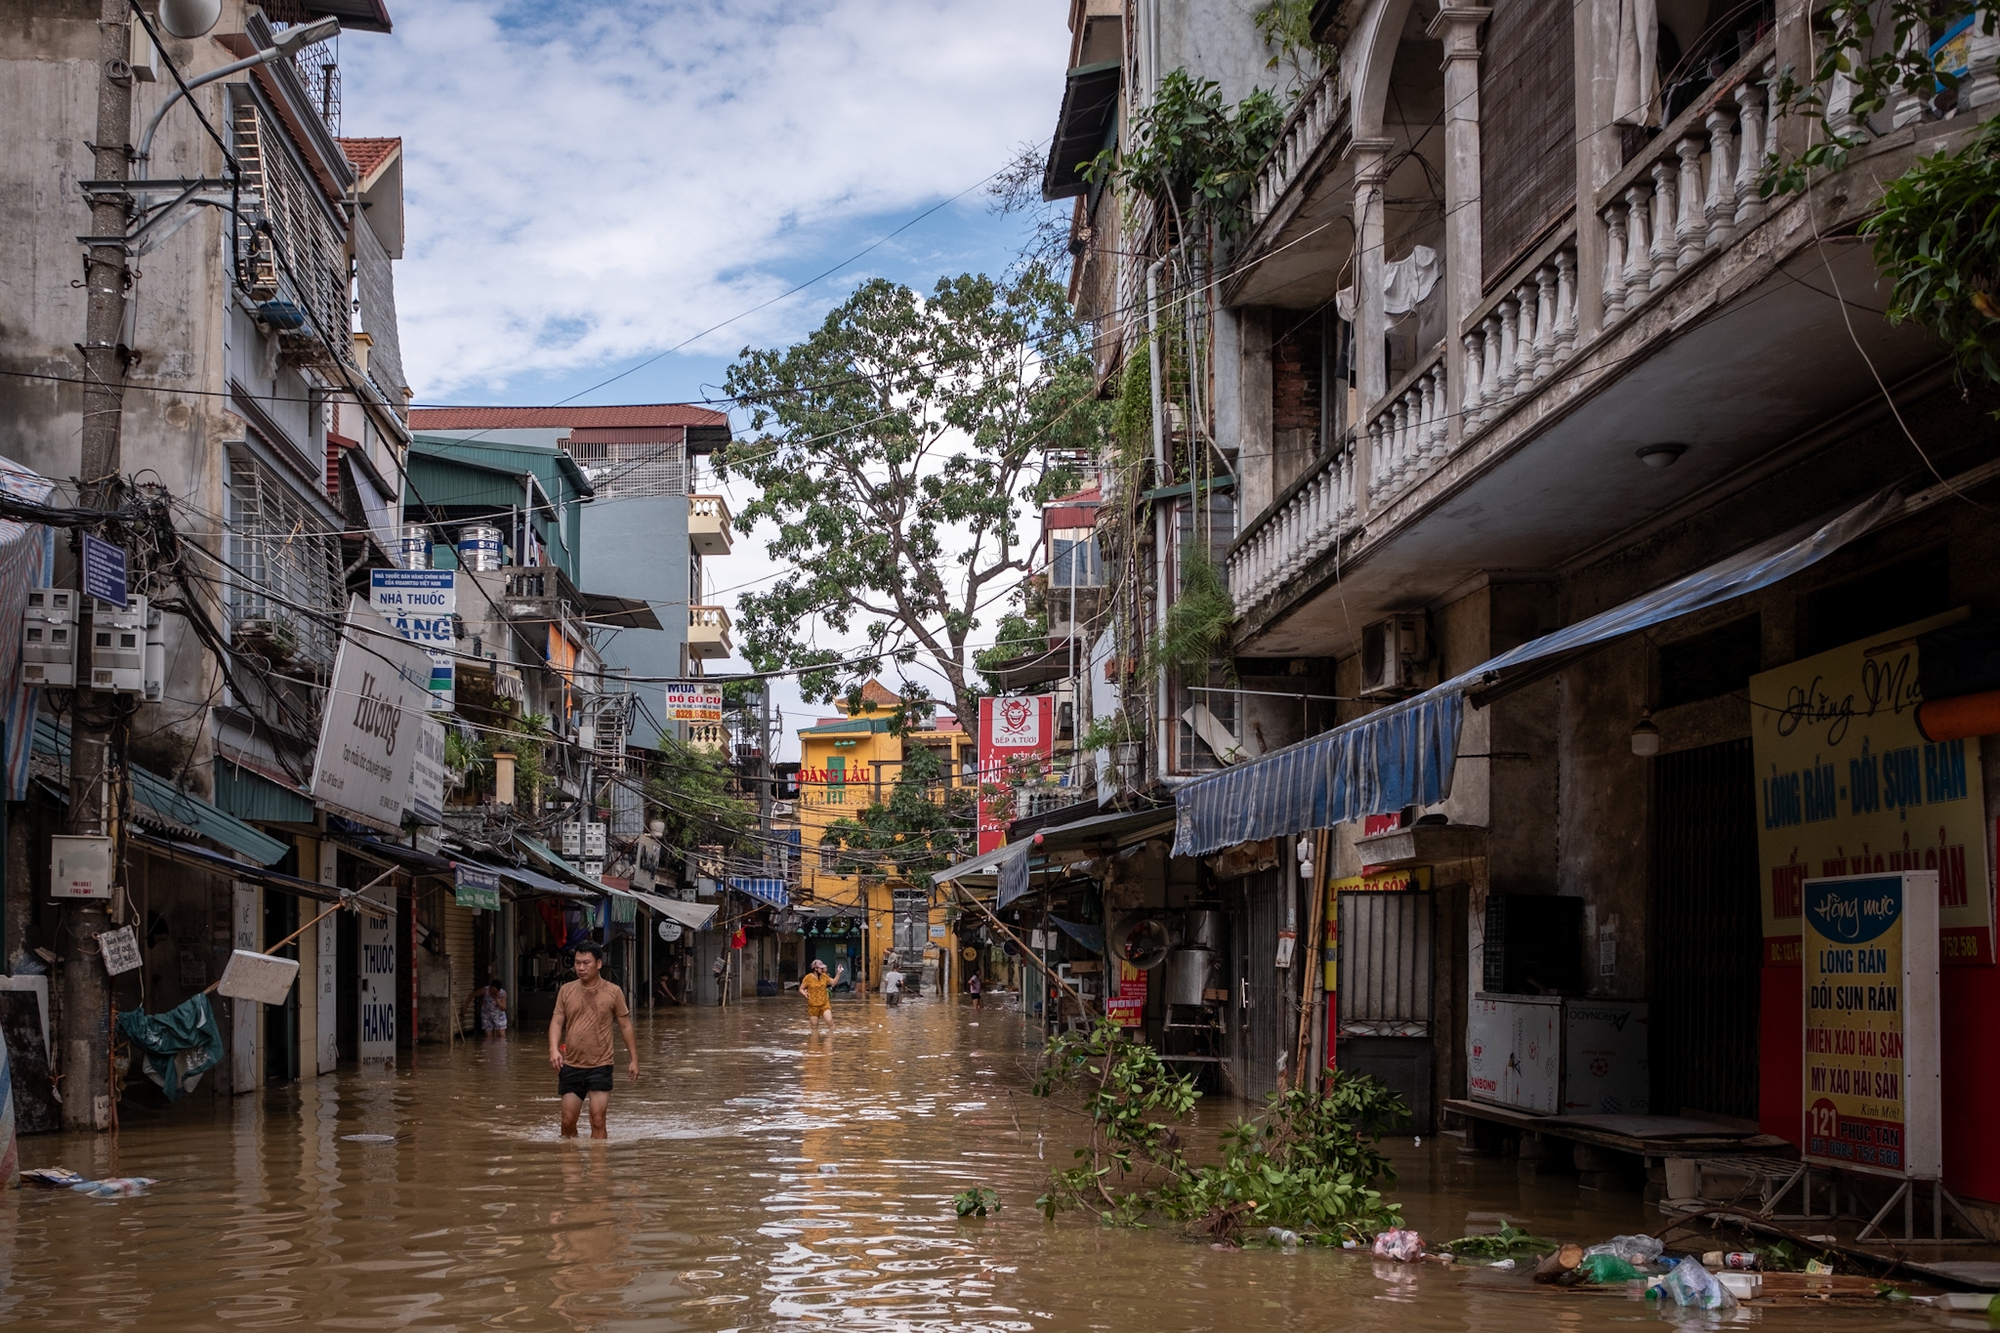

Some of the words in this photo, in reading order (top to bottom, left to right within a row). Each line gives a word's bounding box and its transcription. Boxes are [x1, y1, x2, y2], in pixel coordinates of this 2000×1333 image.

[380, 590, 403, 605] NHÀ
[406, 590, 446, 606] THUỐC
[385, 607, 451, 641] ẰNG
[668, 684, 696, 693] MUA
[352, 670, 403, 757] Hương
[1777, 675, 1854, 746] Hằng
[995, 734, 1010, 744] BẾP
[366, 757, 380, 777] chuyên
[799, 765, 839, 783] ĐĂNG
[842, 758, 870, 782] LẨU
[981, 748, 1001, 784] LẨU
[1762, 763, 1801, 830] LÒNG
[1803, 753, 1837, 824] RÁN
[1850, 735, 1881, 816] DỒI
[1882, 745, 1922, 822] SỤN
[1813, 892, 1860, 939] Hằng
[1863, 894, 1895, 921] mực
[363, 933, 394, 974] THUỐC
[1782, 942, 1794, 961] 121
[1820, 944, 1853, 974] LÒNG
[1858, 943, 1886, 974] RÁN
[1942, 936, 1960, 958] 752
[1961, 935, 1978, 957] 588
[1811, 977, 1832, 1010] DỒI
[1836, 985, 1863, 1016] SỤN
[1868, 981, 1897, 1012] RÁN
[363, 986, 394, 1043] HẰNG
[1806, 1020, 1832, 1054] MIẾN
[1834, 1024, 1855, 1056] XÀO
[1858, 1020, 1877, 1057] HẢI
[1880, 1020, 1904, 1059] SẢN
[1811, 1062, 1827, 1092] MỲ
[1829, 1063, 1850, 1095] XÀO
[1853, 1059, 1871, 1097] HẢI
[1874, 1061, 1898, 1100] SẢN
[1811, 1106, 1837, 1138] 121
[1860, 1103, 1880, 1118] Kính
[1880, 1105, 1900, 1120] Mời!
[1840, 1119, 1872, 1143] PHÚC
[1875, 1123, 1899, 1146] TÂN
[1829, 1140, 1854, 1159] 0984
[1856, 1145, 1876, 1163] 752
[1879, 1148, 1900, 1167] 588
